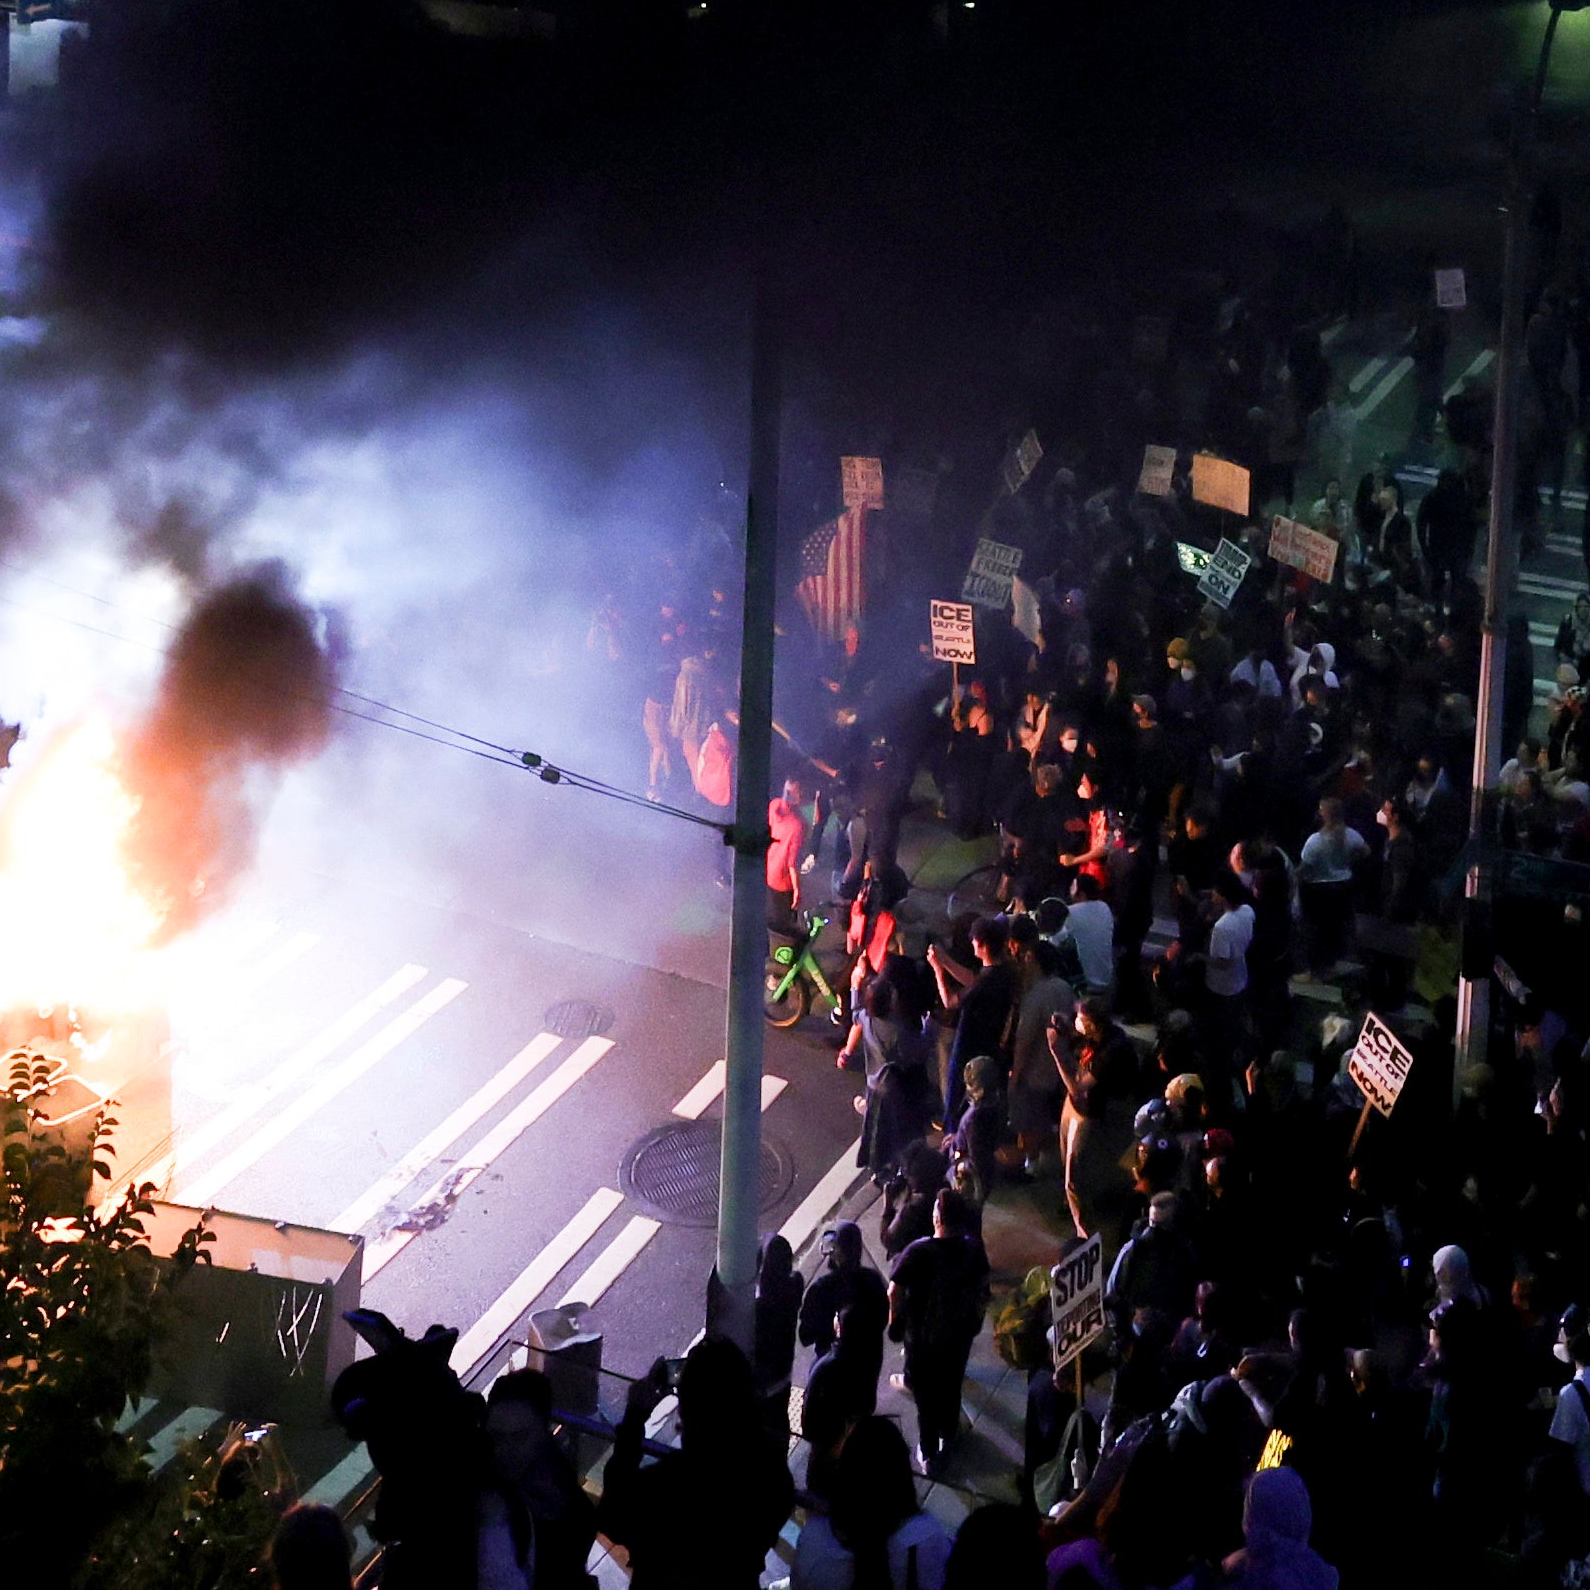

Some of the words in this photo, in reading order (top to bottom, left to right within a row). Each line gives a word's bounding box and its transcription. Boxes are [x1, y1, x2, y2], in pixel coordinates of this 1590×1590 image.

[932, 603, 972, 623] ICE
[934, 646, 973, 660] NOW
[1361, 1034, 1386, 1063] OUT
[1365, 1016, 1410, 1077] ICE
[1351, 1060, 1392, 1111] NOW
[1055, 1242, 1101, 1307] STOP
